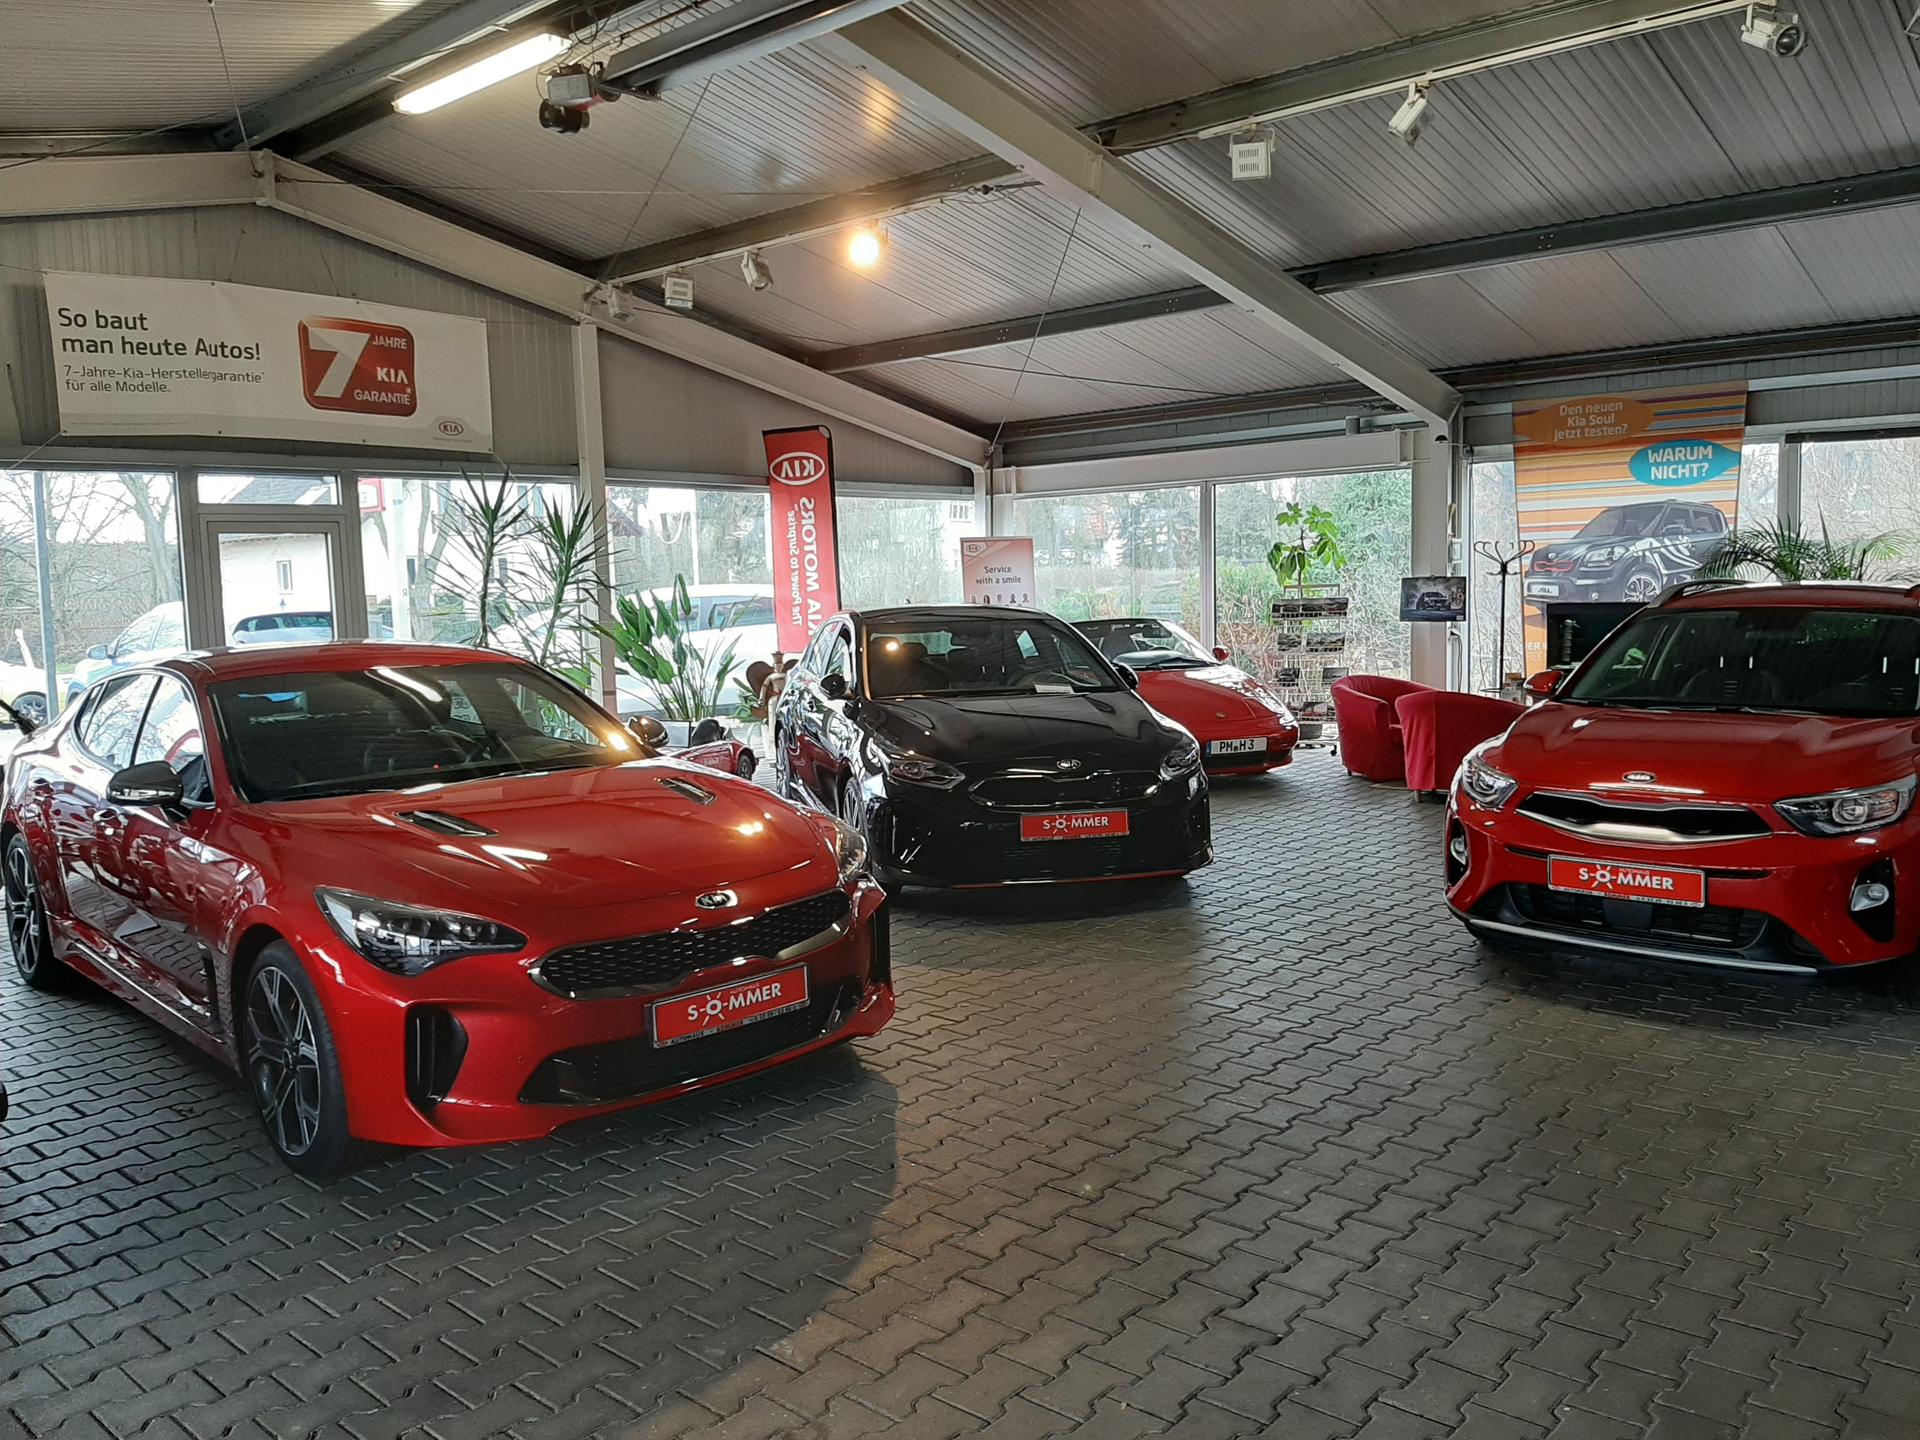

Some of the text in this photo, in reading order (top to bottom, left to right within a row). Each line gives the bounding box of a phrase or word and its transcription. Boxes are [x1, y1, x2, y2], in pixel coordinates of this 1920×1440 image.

[58, 308, 148, 331] So baut
[62, 336, 261, 360] man heute Autos!
[373, 335, 408, 350] JAHRE
[308, 327, 371, 398] 7
[376, 366, 409, 384] KIA
[65, 379, 86, 392] für
[90, 380, 112, 392] alle
[353, 389, 411, 405] GARANTIE
[1559, 402, 1623, 416] Den neuen
[441, 423, 461, 434] KIA
[1567, 413, 1615, 428] Kia Soul
[1553, 424, 1628, 442] jetzt testen?
[1648, 445, 1713, 464] WARUM
[1650, 463, 1710, 481] NICHT?
[984, 565, 1012, 574] Service
[975, 577, 993, 585] with
[1002, 575, 1022, 584] smile
[1220, 741, 1233, 752] PM
[1578, 866, 1674, 891] SOMMER
[687, 982, 782, 1022] SOMMER
